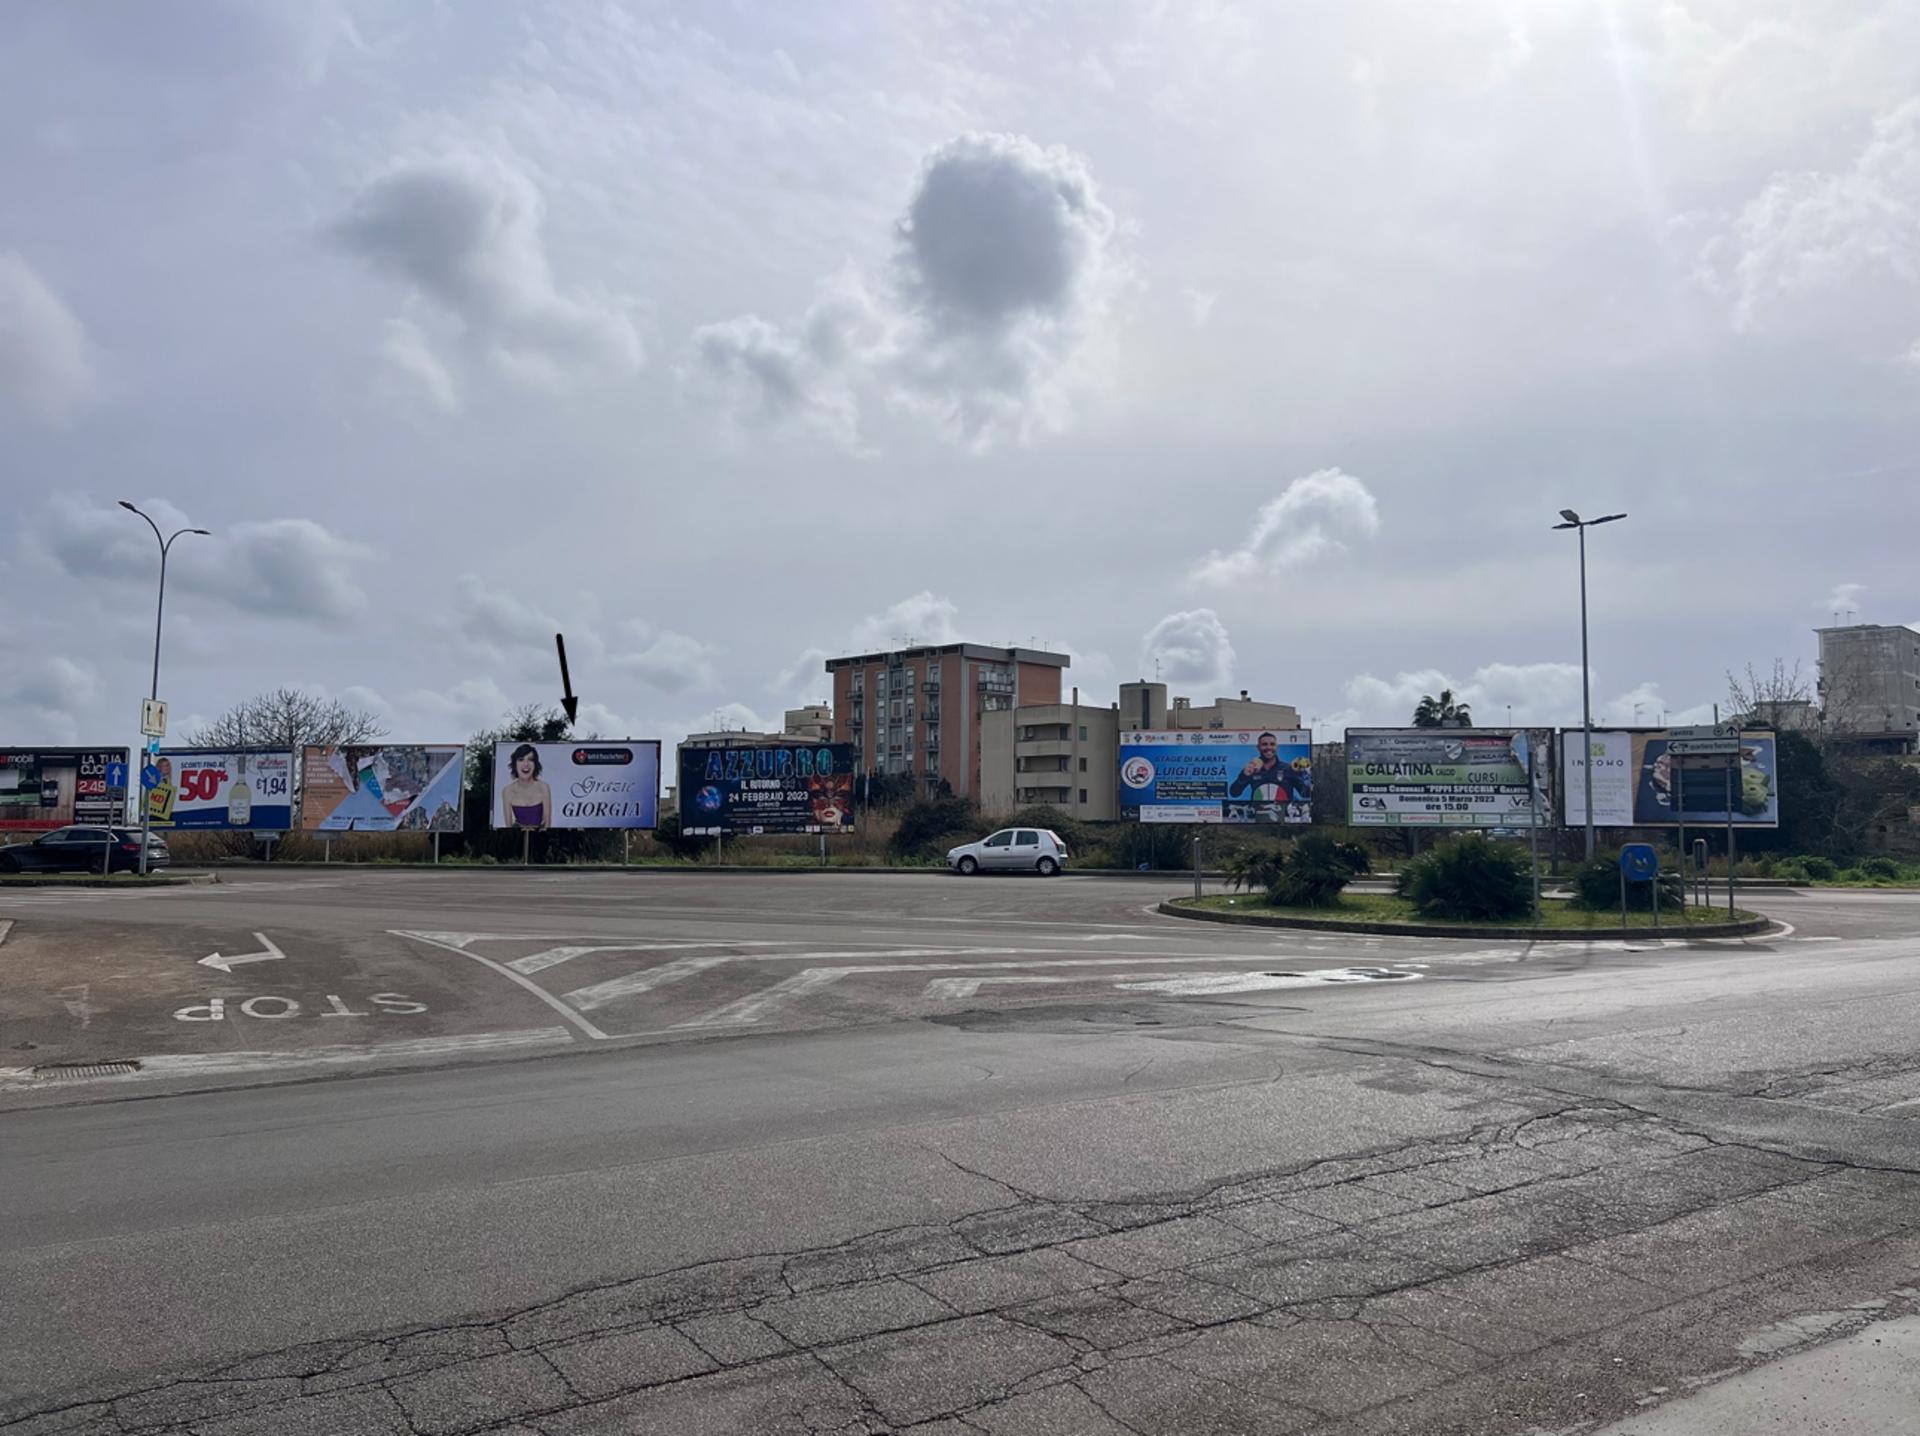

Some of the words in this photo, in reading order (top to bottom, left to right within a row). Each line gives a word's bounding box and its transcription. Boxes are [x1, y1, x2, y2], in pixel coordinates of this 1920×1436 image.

[82, 755, 95, 764] LA
[704, 748, 833, 780] AZZURRO
[1155, 767, 1189, 776] LUIGI
[1192, 764, 1228, 776] BUSÀ
[1365, 763, 1434, 776] GALATINA
[1435, 768, 1456, 776] CALCIO
[1468, 772, 1498, 783] CURSI
[79, 781, 106, 792] 2.49
[570, 775, 636, 798] Grazie
[741, 780, 749, 790] IL
[750, 779, 781, 790] RITORNO
[728, 792, 740, 803] 24
[742, 792, 784, 802] FEBBRAIO
[786, 791, 809, 801] 2023
[1398, 795, 1440, 803] Domenica
[1441, 795, 1447, 803] 5
[1448, 795, 1473, 803] Marzo
[1474, 795, 1495, 803] 2023
[562, 801, 640, 817] GIORGIA
[1425, 803, 1442, 811] ore
[1443, 803, 1469, 811] 15.00
[172, 991, 429, 1021] STOP
